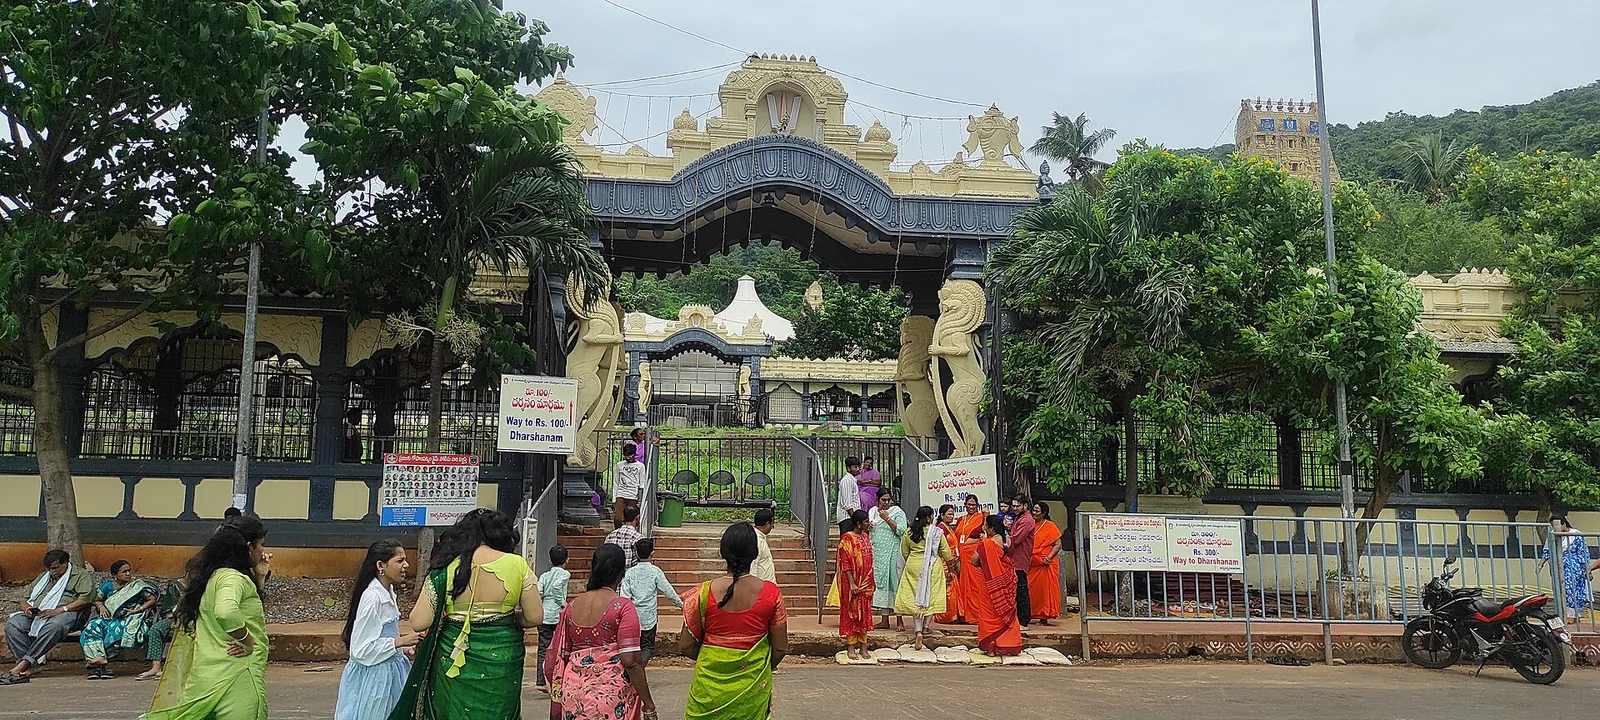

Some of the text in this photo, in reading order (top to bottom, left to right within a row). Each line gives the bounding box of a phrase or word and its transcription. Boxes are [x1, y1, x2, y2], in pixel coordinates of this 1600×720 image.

[506, 416, 523, 428] Way
[536, 418, 547, 427] Rs.
[551, 419, 568, 428] 100/-
[510, 431, 563, 442] Dharshanam
[945, 494, 955, 502] Rs.
[1173, 557, 1187, 565] Way
